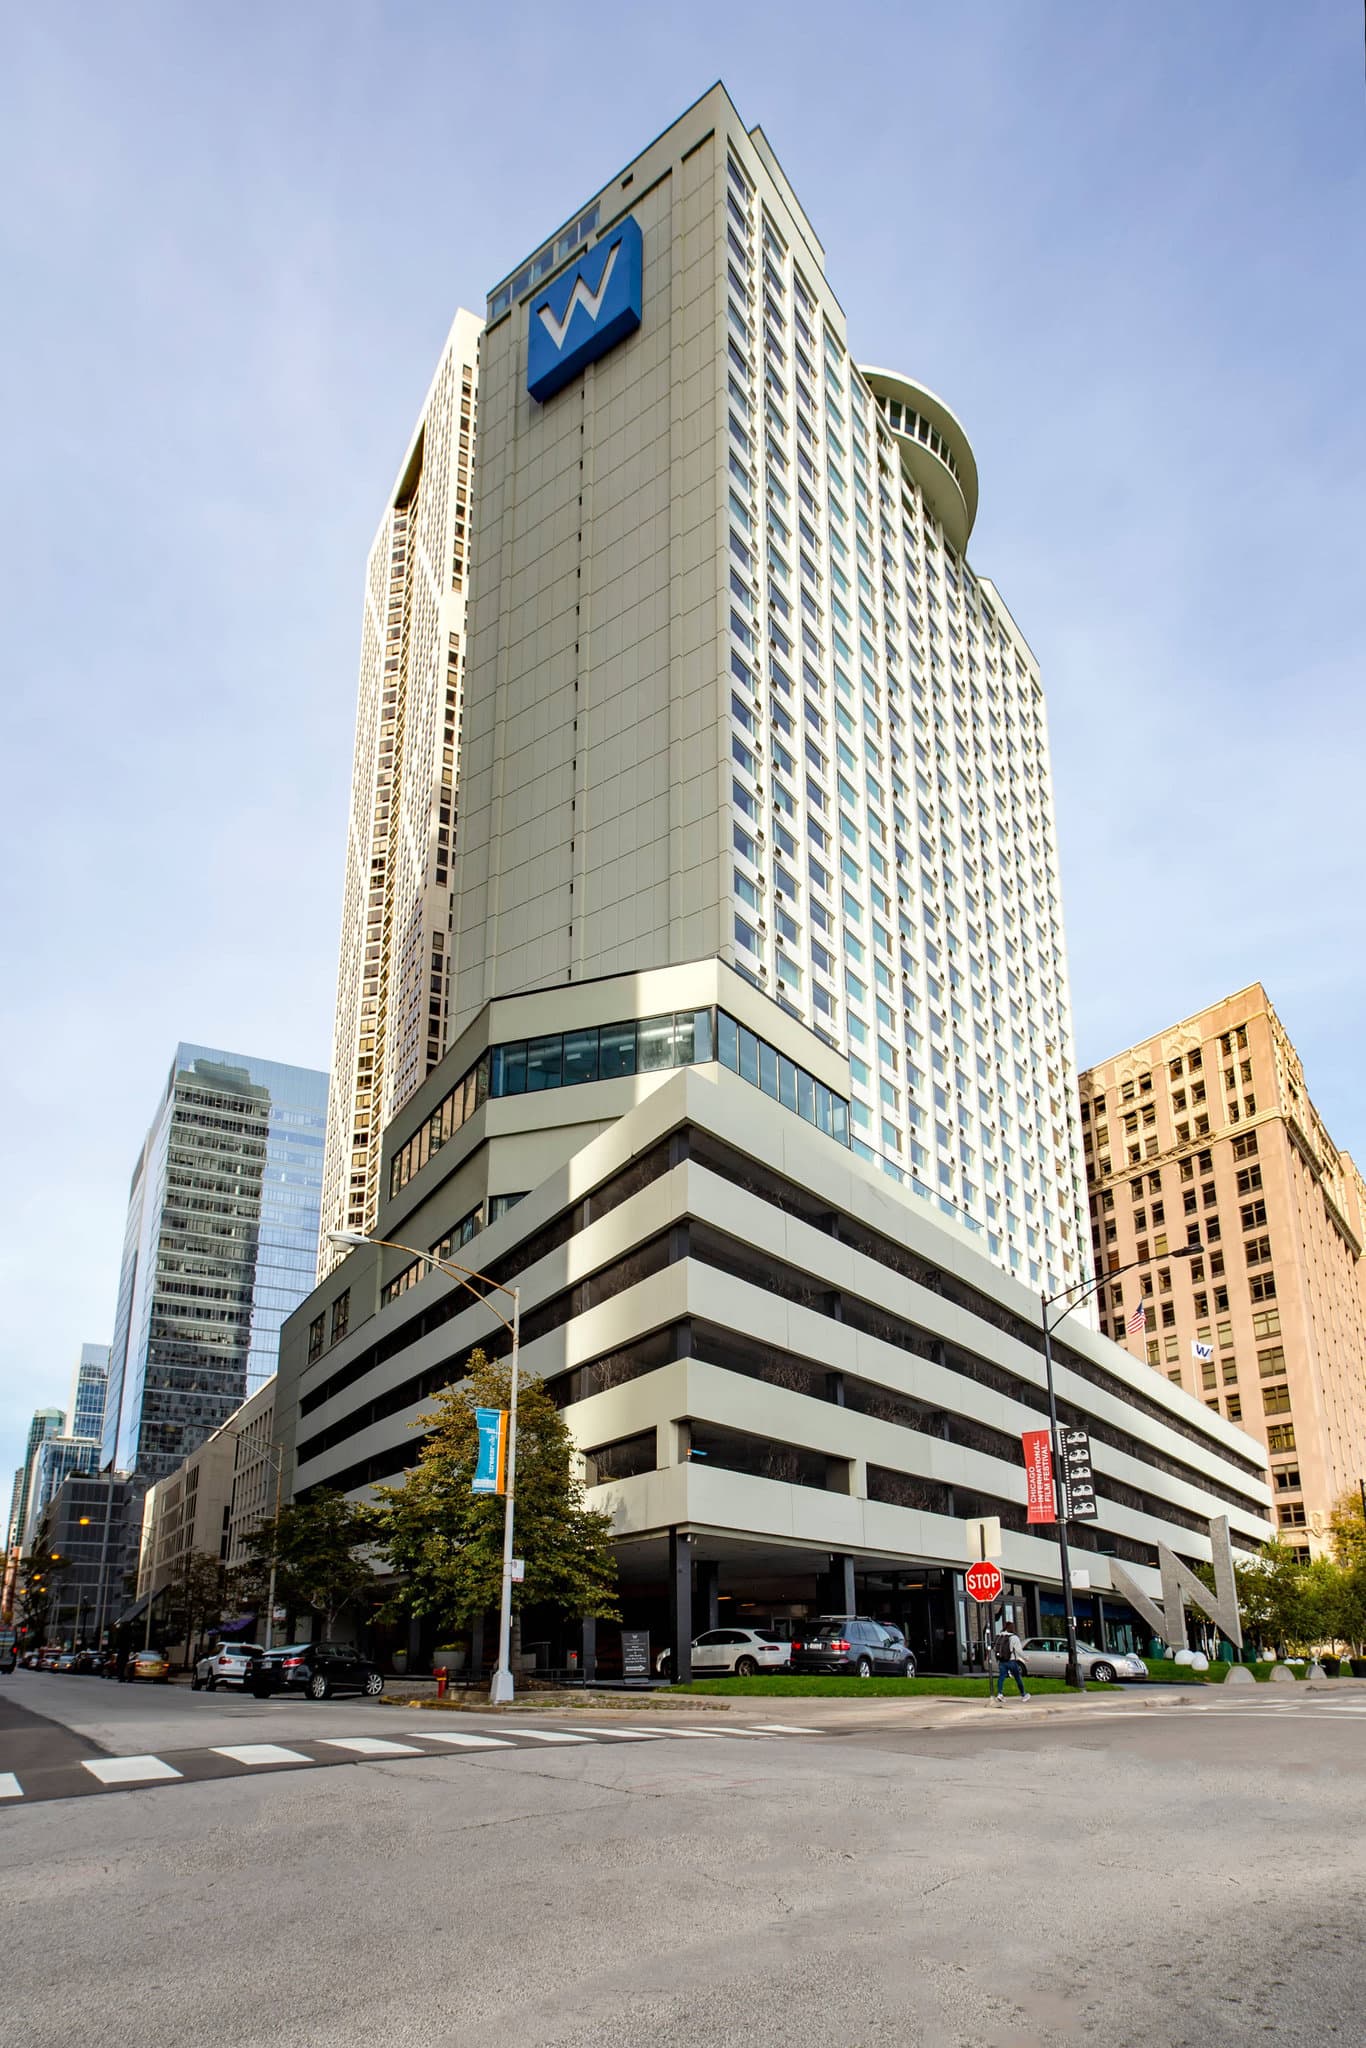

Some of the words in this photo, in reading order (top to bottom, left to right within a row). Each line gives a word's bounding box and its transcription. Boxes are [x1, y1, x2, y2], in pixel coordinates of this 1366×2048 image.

[537, 238, 622, 350] W
[1196, 1344, 1210, 1358] W
[1033, 1440, 1044, 1503] INTERNATIONAL
[1041, 1444, 1050, 1481] FESTIVAL
[1029, 1467, 1037, 1503] CHICAGO
[968, 1573, 999, 1589] STOP
